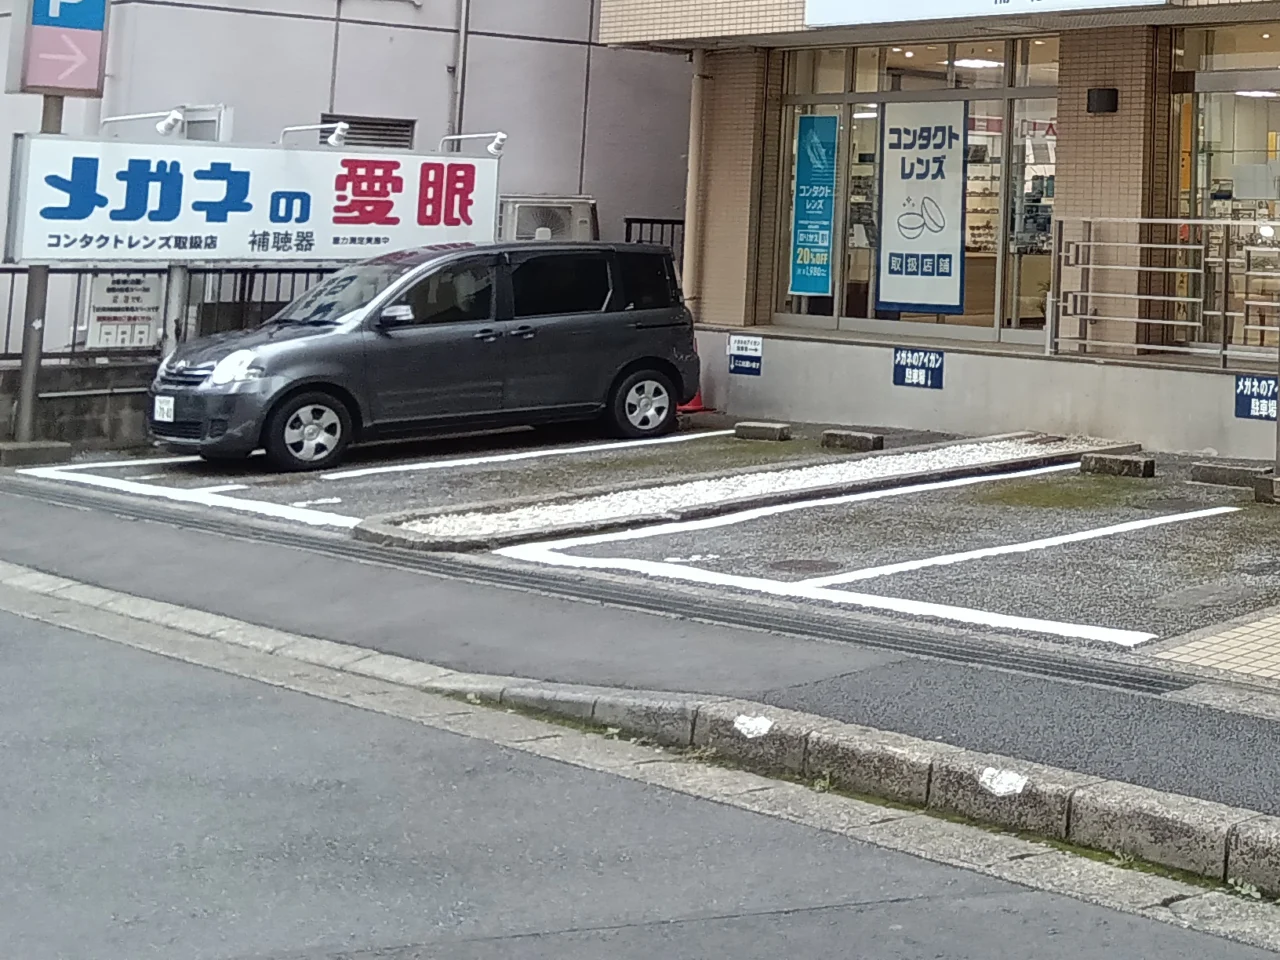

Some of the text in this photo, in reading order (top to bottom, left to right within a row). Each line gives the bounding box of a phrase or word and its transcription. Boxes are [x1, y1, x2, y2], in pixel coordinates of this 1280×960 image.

[888, 125, 960, 150] コンタクト
[900, 155, 947, 180] レンズ
[39, 156, 477, 227] メガネの愛眼
[798, 185, 832, 197] コンタクト
[805, 199, 825, 210] レンズ
[46, 233, 218, 250] コンタクトレンズ取扱店
[248, 230, 316, 253] 補聴器
[890, 255, 952, 274] 取扱店舗
[895, 350, 942, 369] メガネのアイガン
[905, 368, 926, 386] 駐車場
